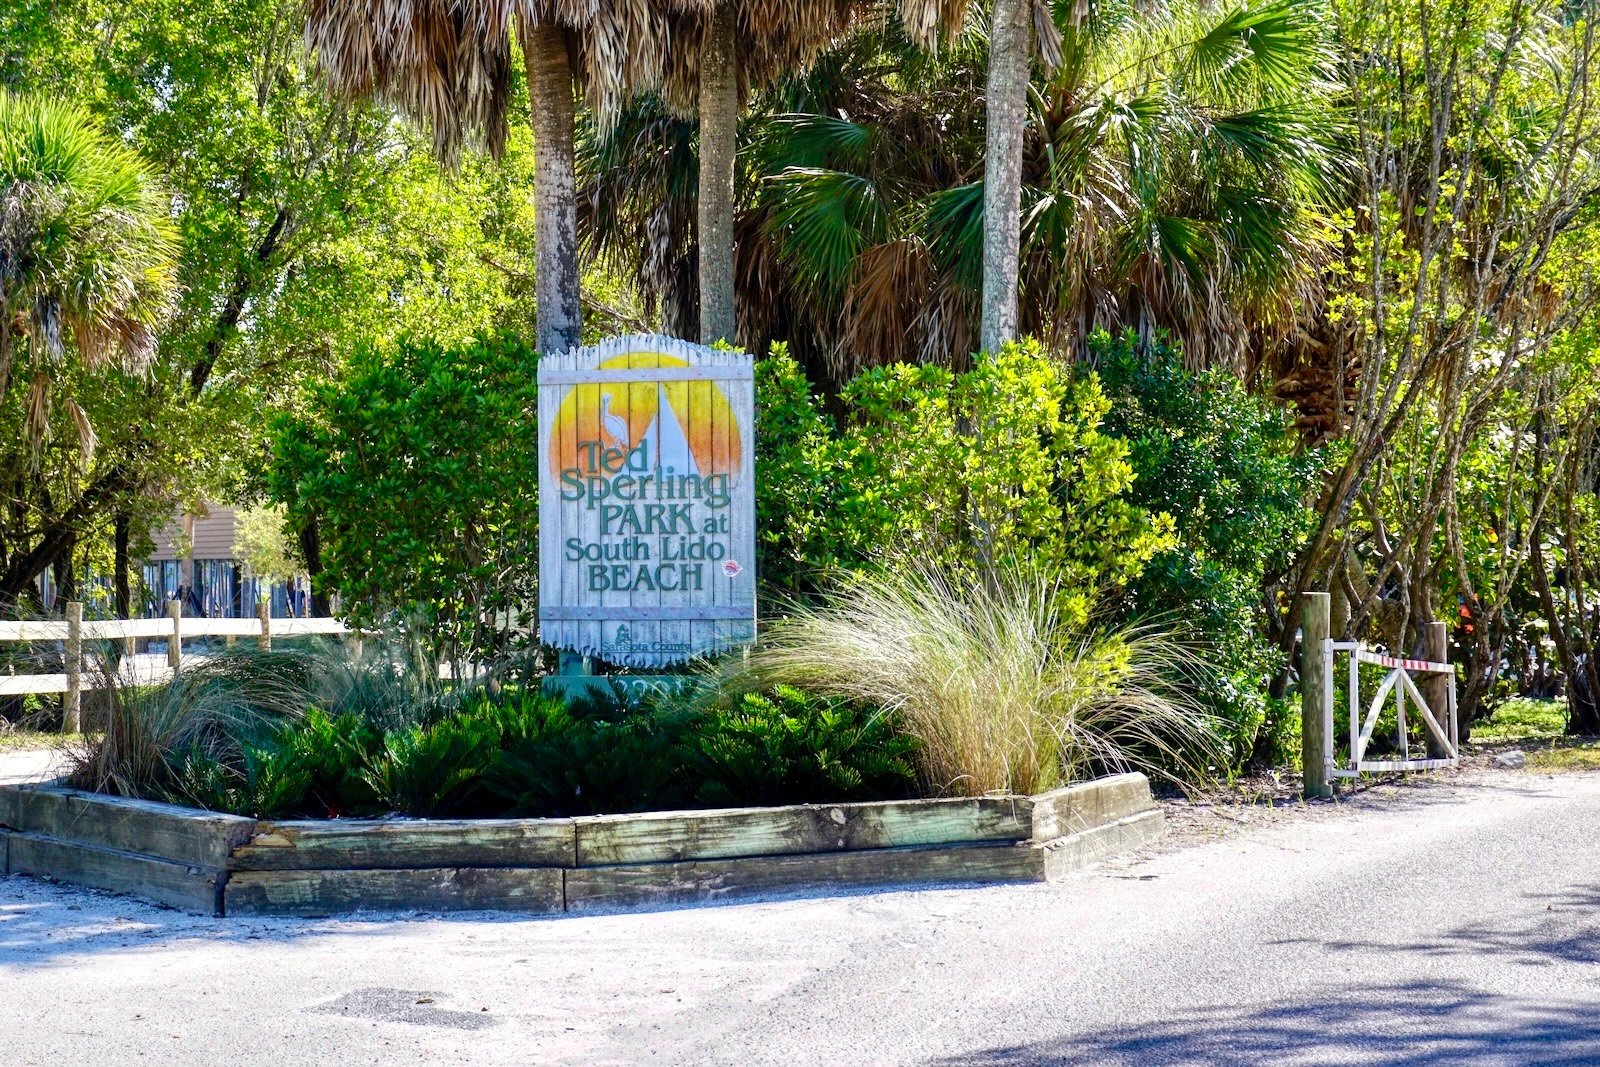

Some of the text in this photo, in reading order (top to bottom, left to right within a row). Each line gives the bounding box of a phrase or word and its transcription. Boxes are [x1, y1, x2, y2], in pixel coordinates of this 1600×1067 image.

[578, 438, 648, 473] Ted
[560, 465, 731, 509] Sperling
[600, 504, 729, 535] PARK at
[565, 536, 726, 561] South Lido
[588, 563, 703, 591] BEACH
[602, 641, 691, 652] Sarasota County
